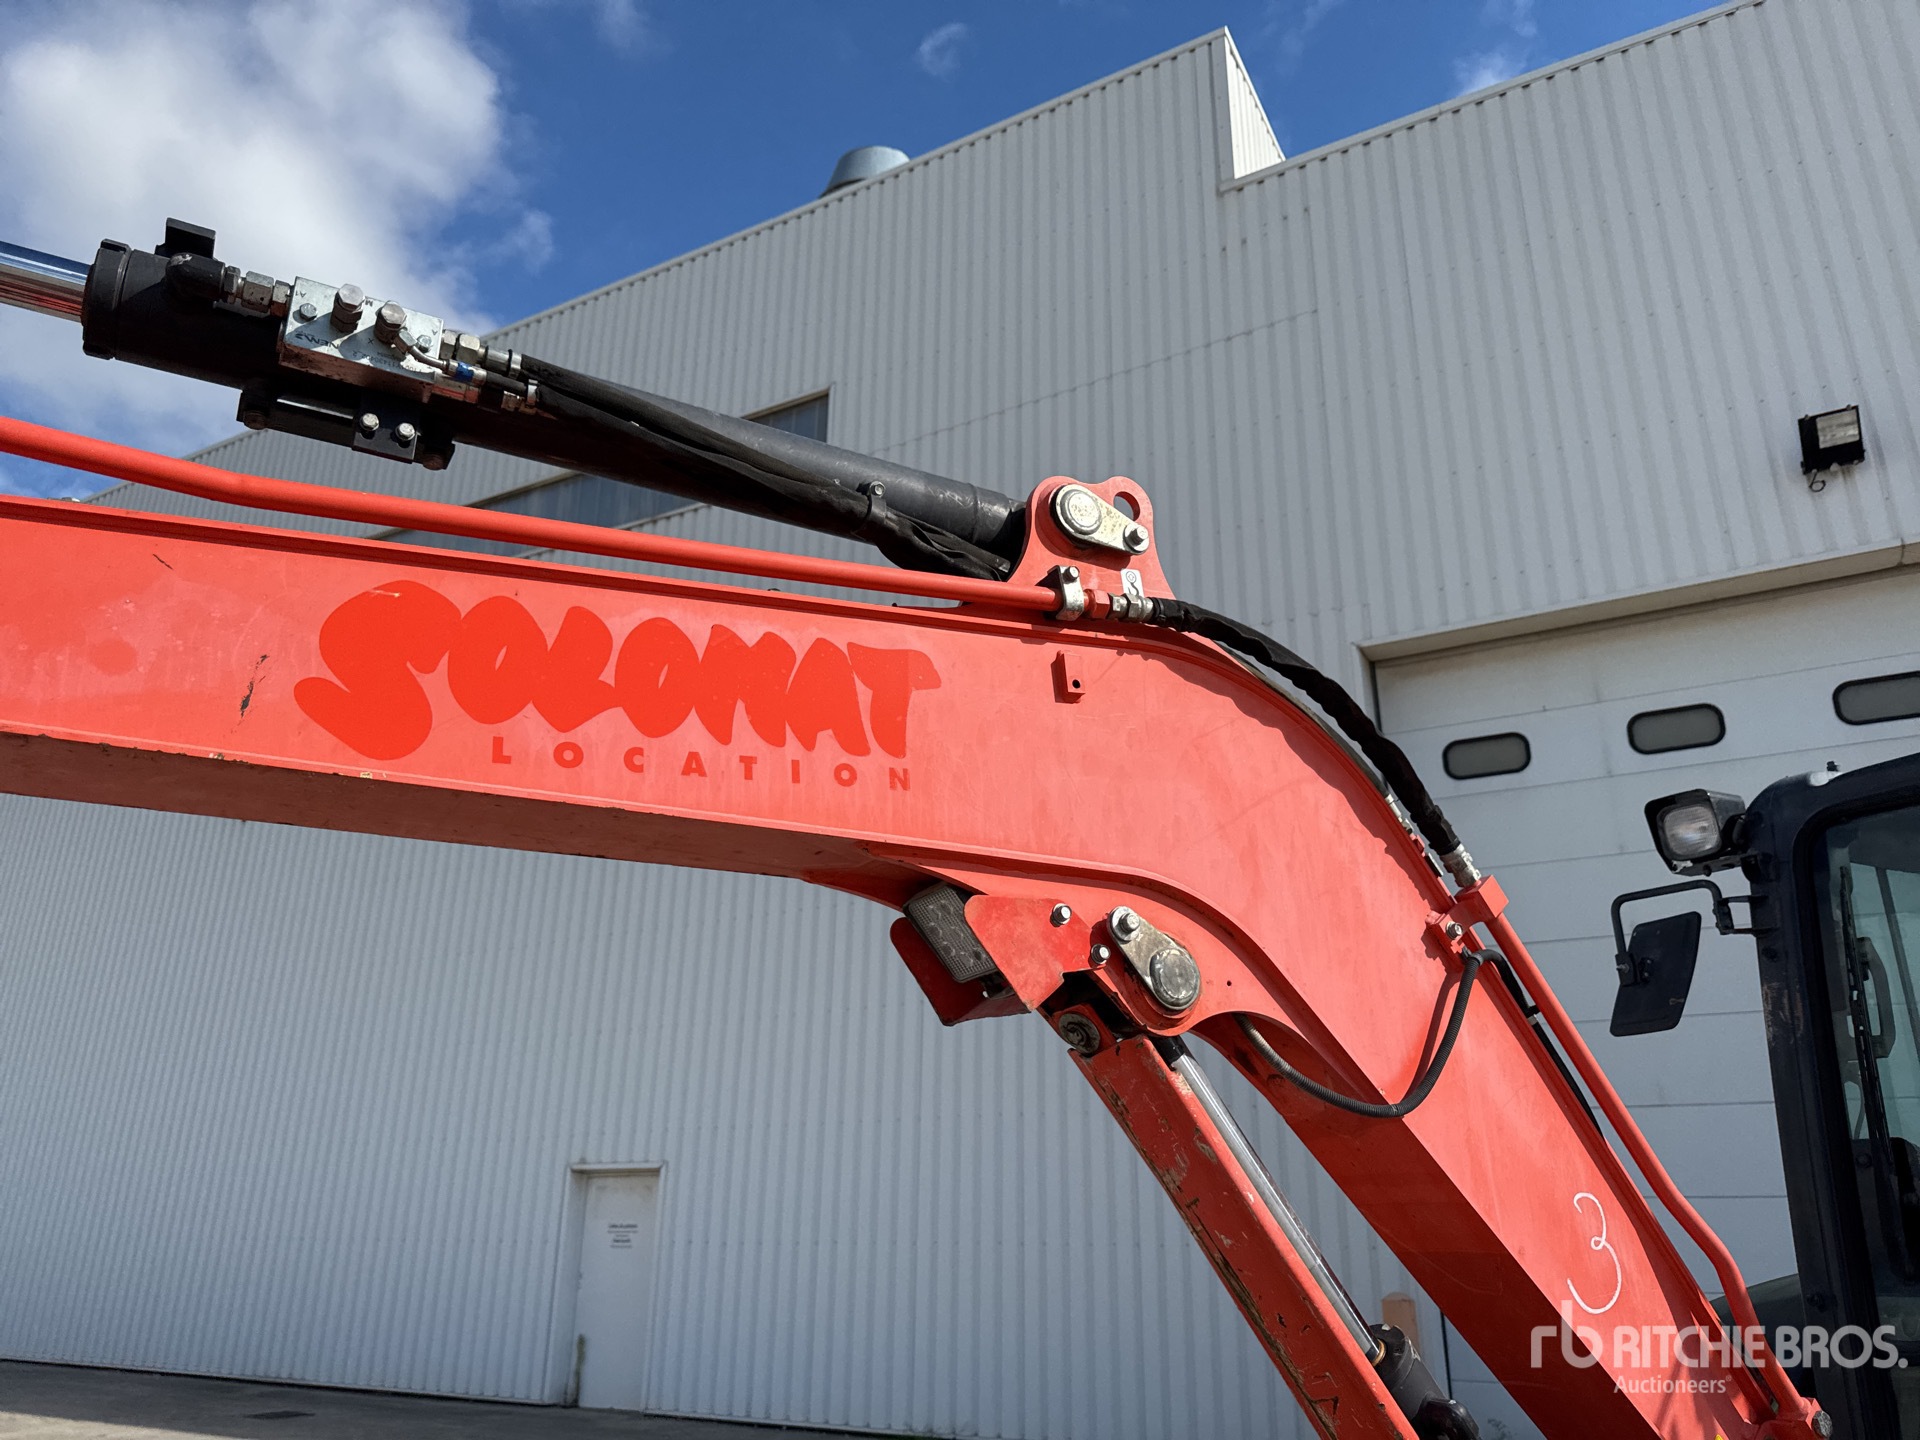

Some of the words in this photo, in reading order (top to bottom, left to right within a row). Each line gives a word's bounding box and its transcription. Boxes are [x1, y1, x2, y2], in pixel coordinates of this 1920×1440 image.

[295, 290, 306, 298] A1
[293, 580, 942, 760] SOLOMAT
[491, 735, 912, 792] LOCATION
[1566, 1191, 1623, 1315] 3
